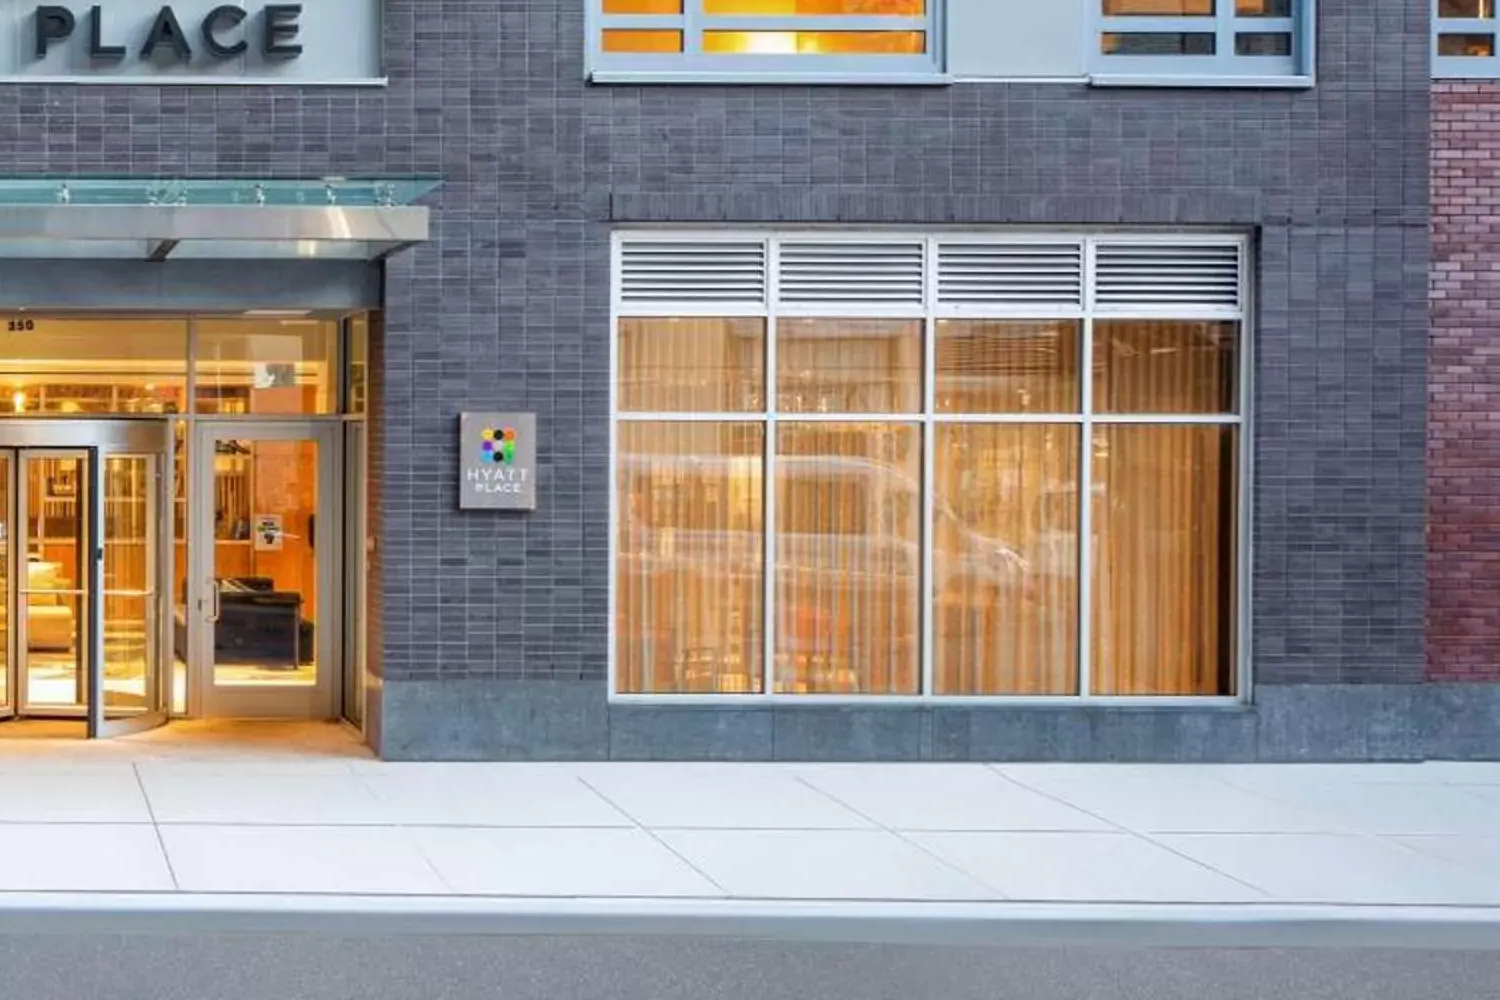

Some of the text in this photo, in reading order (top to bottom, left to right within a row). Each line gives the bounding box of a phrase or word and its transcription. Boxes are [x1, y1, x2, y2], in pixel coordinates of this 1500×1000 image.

[35, 3, 304, 59] PLACE
[7, 319, 35, 331] 350
[467, 468, 528, 481] HYATT
[475, 483, 521, 493] PLACE
